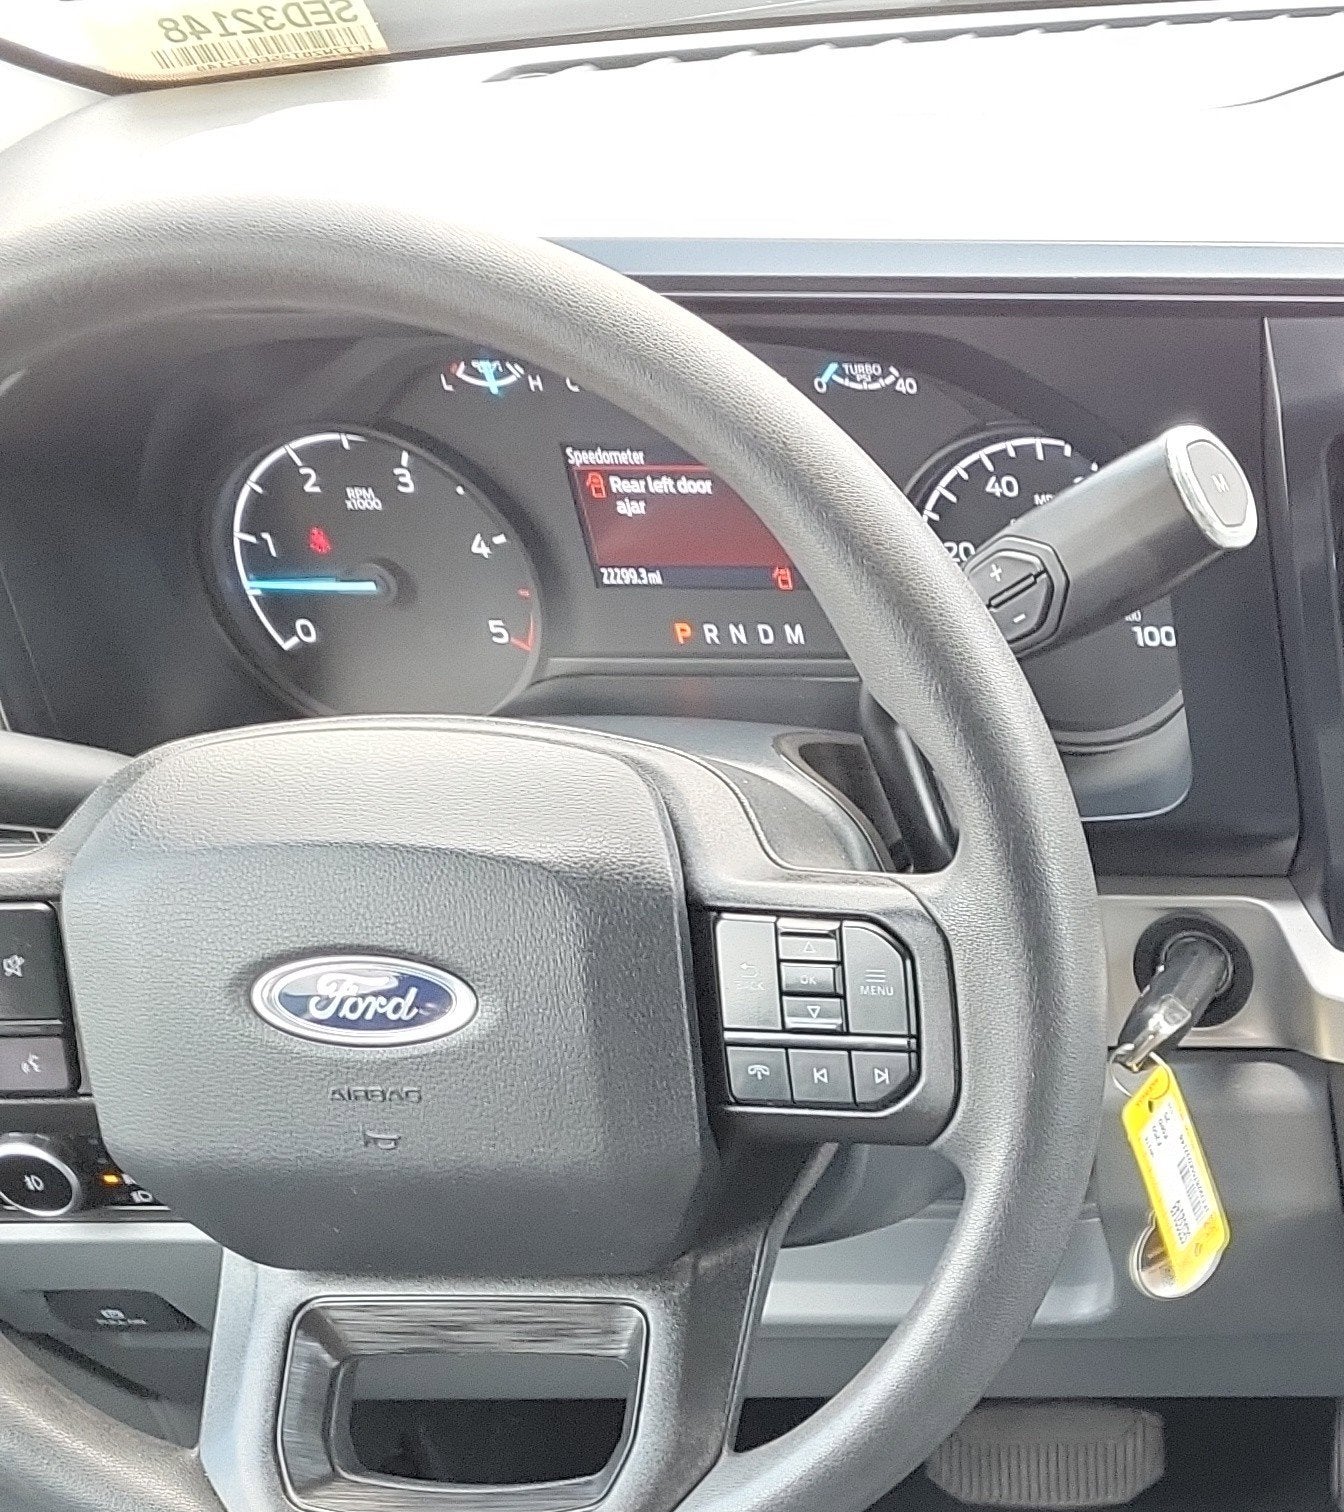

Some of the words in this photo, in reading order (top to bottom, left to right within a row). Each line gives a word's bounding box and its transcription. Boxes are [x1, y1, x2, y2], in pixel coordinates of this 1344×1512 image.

[842, 363, 882, 376] TURBO
[440, 373, 454, 391] L
[527, 374, 544, 392] H
[895, 377, 917, 395] 40
[565, 446, 645, 467] Speedometer
[299, 467, 322, 493] 2
[393, 467, 415, 493] 3
[609, 475, 646, 494] Rear
[646, 474, 677, 495] left
[676, 475, 713, 495] door
[985, 474, 1019, 498] 40
[1211, 473, 1230, 493] M
[346, 486, 375, 500] RPM
[615, 497, 647, 518] ajar
[261, 531, 277, 557] 1
[470, 532, 492, 558] 4
[295, 618, 317, 642] 0
[487, 618, 510, 644] 5
[674, 622, 692, 645] P
[702, 622, 721, 645] R
[728, 622, 748, 645] N
[756, 622, 775, 645] D
[783, 622, 805, 646] M
[1131, 625, 1177, 648] 100
[800, 974, 818, 986] OK
[309, 971, 419, 1021] Ford
[859, 985, 895, 997] MENU
[330, 1086, 422, 1104] AIRBAG
